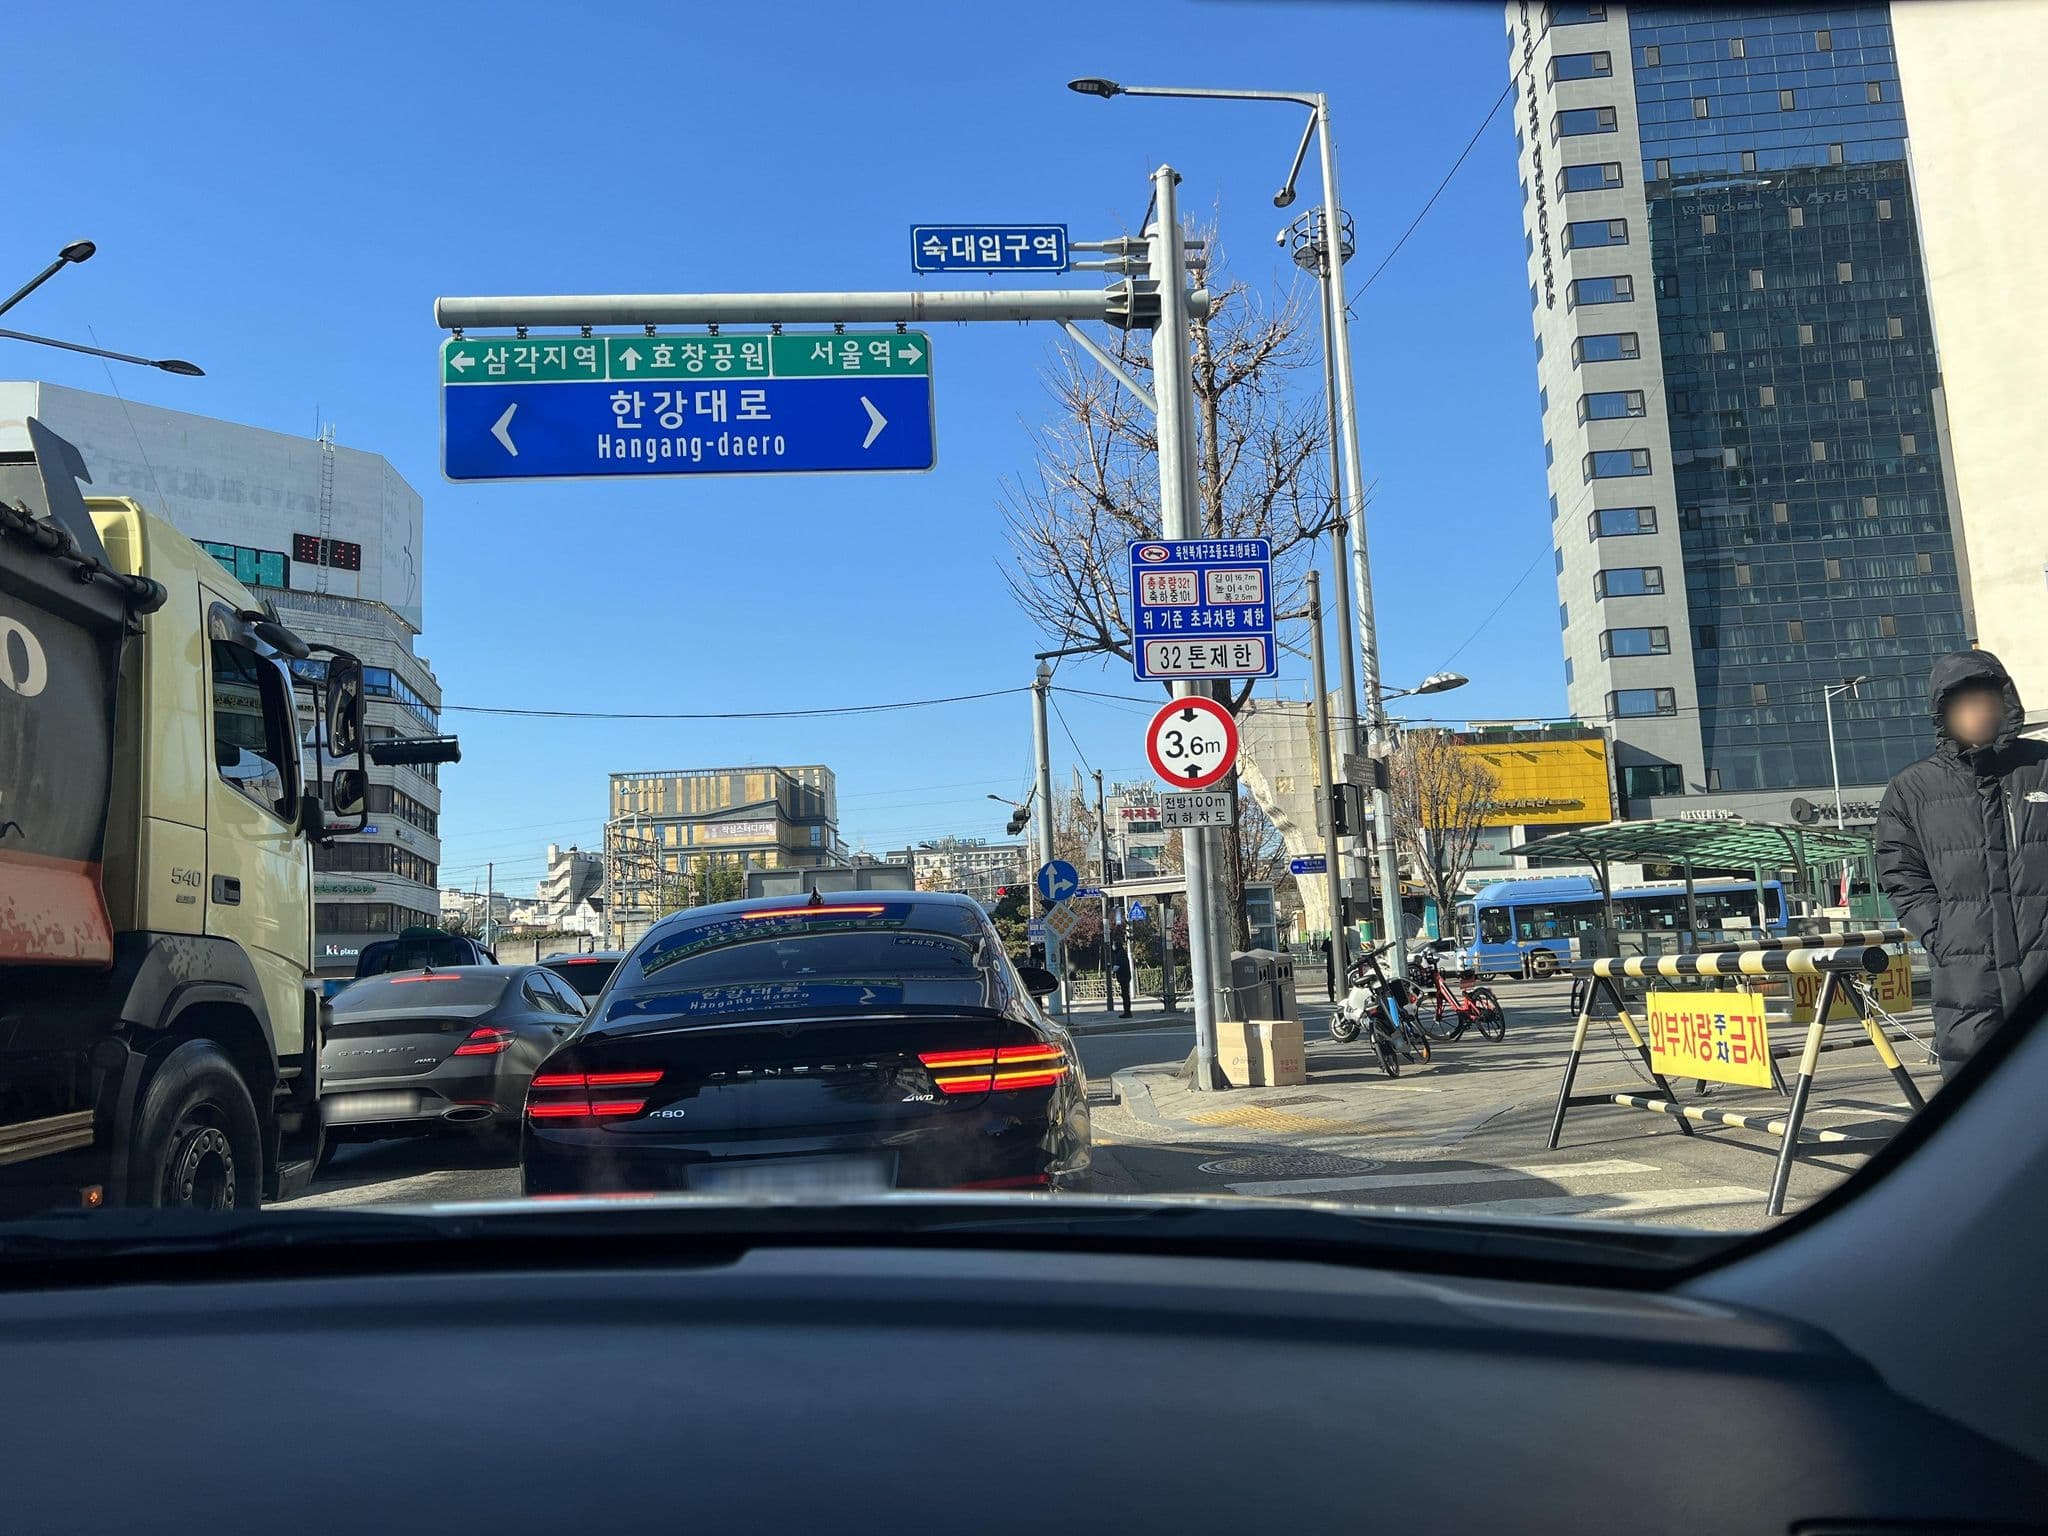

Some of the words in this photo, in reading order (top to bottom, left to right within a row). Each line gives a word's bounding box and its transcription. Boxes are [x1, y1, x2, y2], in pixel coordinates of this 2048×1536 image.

[922, 234, 1057, 262] 숙대입구역
[482, 345, 596, 375] 삼각지역
[650, 342, 764, 372] 효창공원
[810, 340, 891, 369] 서울역
[610, 389, 771, 429] 한강대로
[598, 431, 785, 463] Hangang-daero
[1143, 610, 1153, 630] 위
[1161, 610, 1183, 629] 기준
[1191, 608, 1236, 628] 초과차량
[1243, 607, 1265, 627] 제한
[1165, 730, 1221, 758] 3.6m
[1121, 807, 1161, 821] 지지옥
[1166, 811, 1226, 825] 지하차도
[171, 867, 201, 887] 540
[340, 948, 359, 956] plaza
